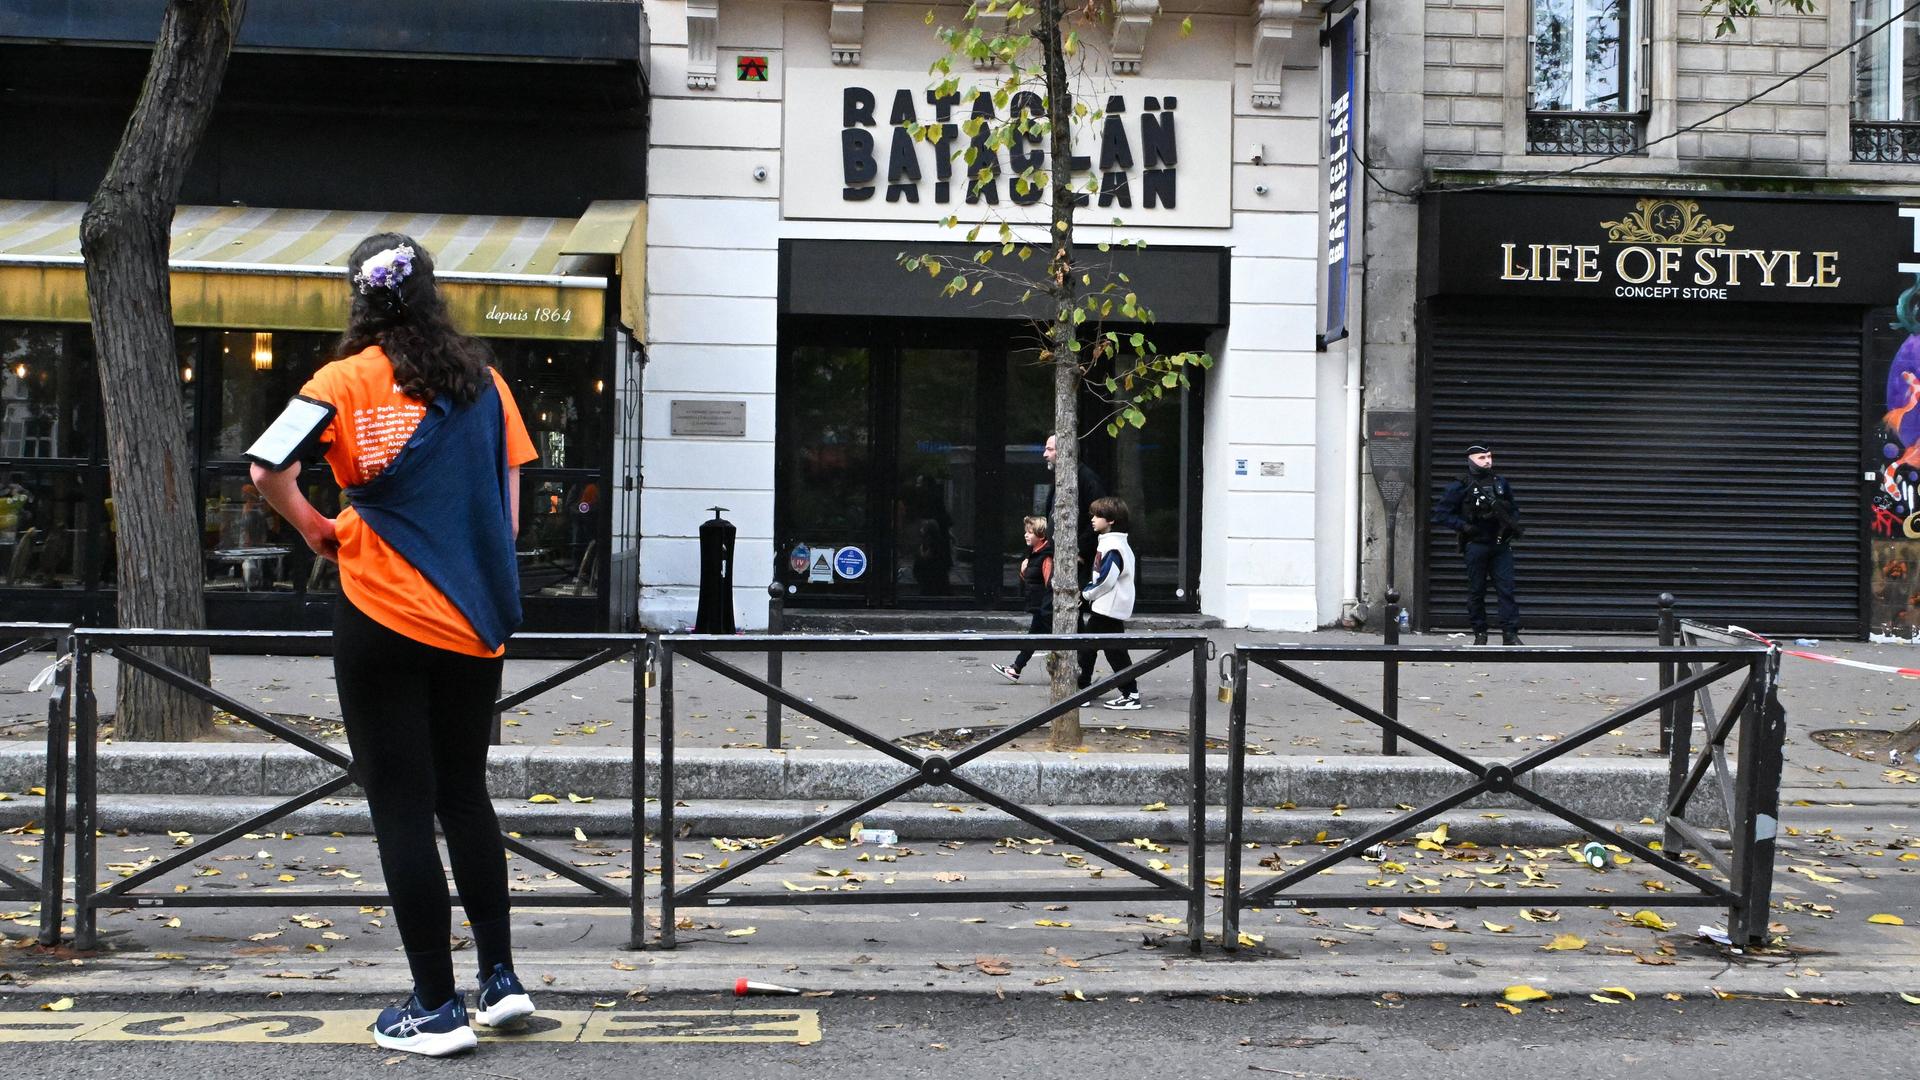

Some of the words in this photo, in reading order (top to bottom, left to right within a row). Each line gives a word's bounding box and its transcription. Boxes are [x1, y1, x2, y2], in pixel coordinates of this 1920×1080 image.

[1500, 243, 1603, 282] LIFE
[1616, 246, 1683, 285] OF
[1694, 248, 1842, 288] STYLE
[1615, 286, 1678, 299] CONCEPT
[1682, 287, 1728, 300] STORE
[486, 304, 528, 324] depuis
[534, 307, 572, 323] 1864
[377, 405, 395, 413] Paris
